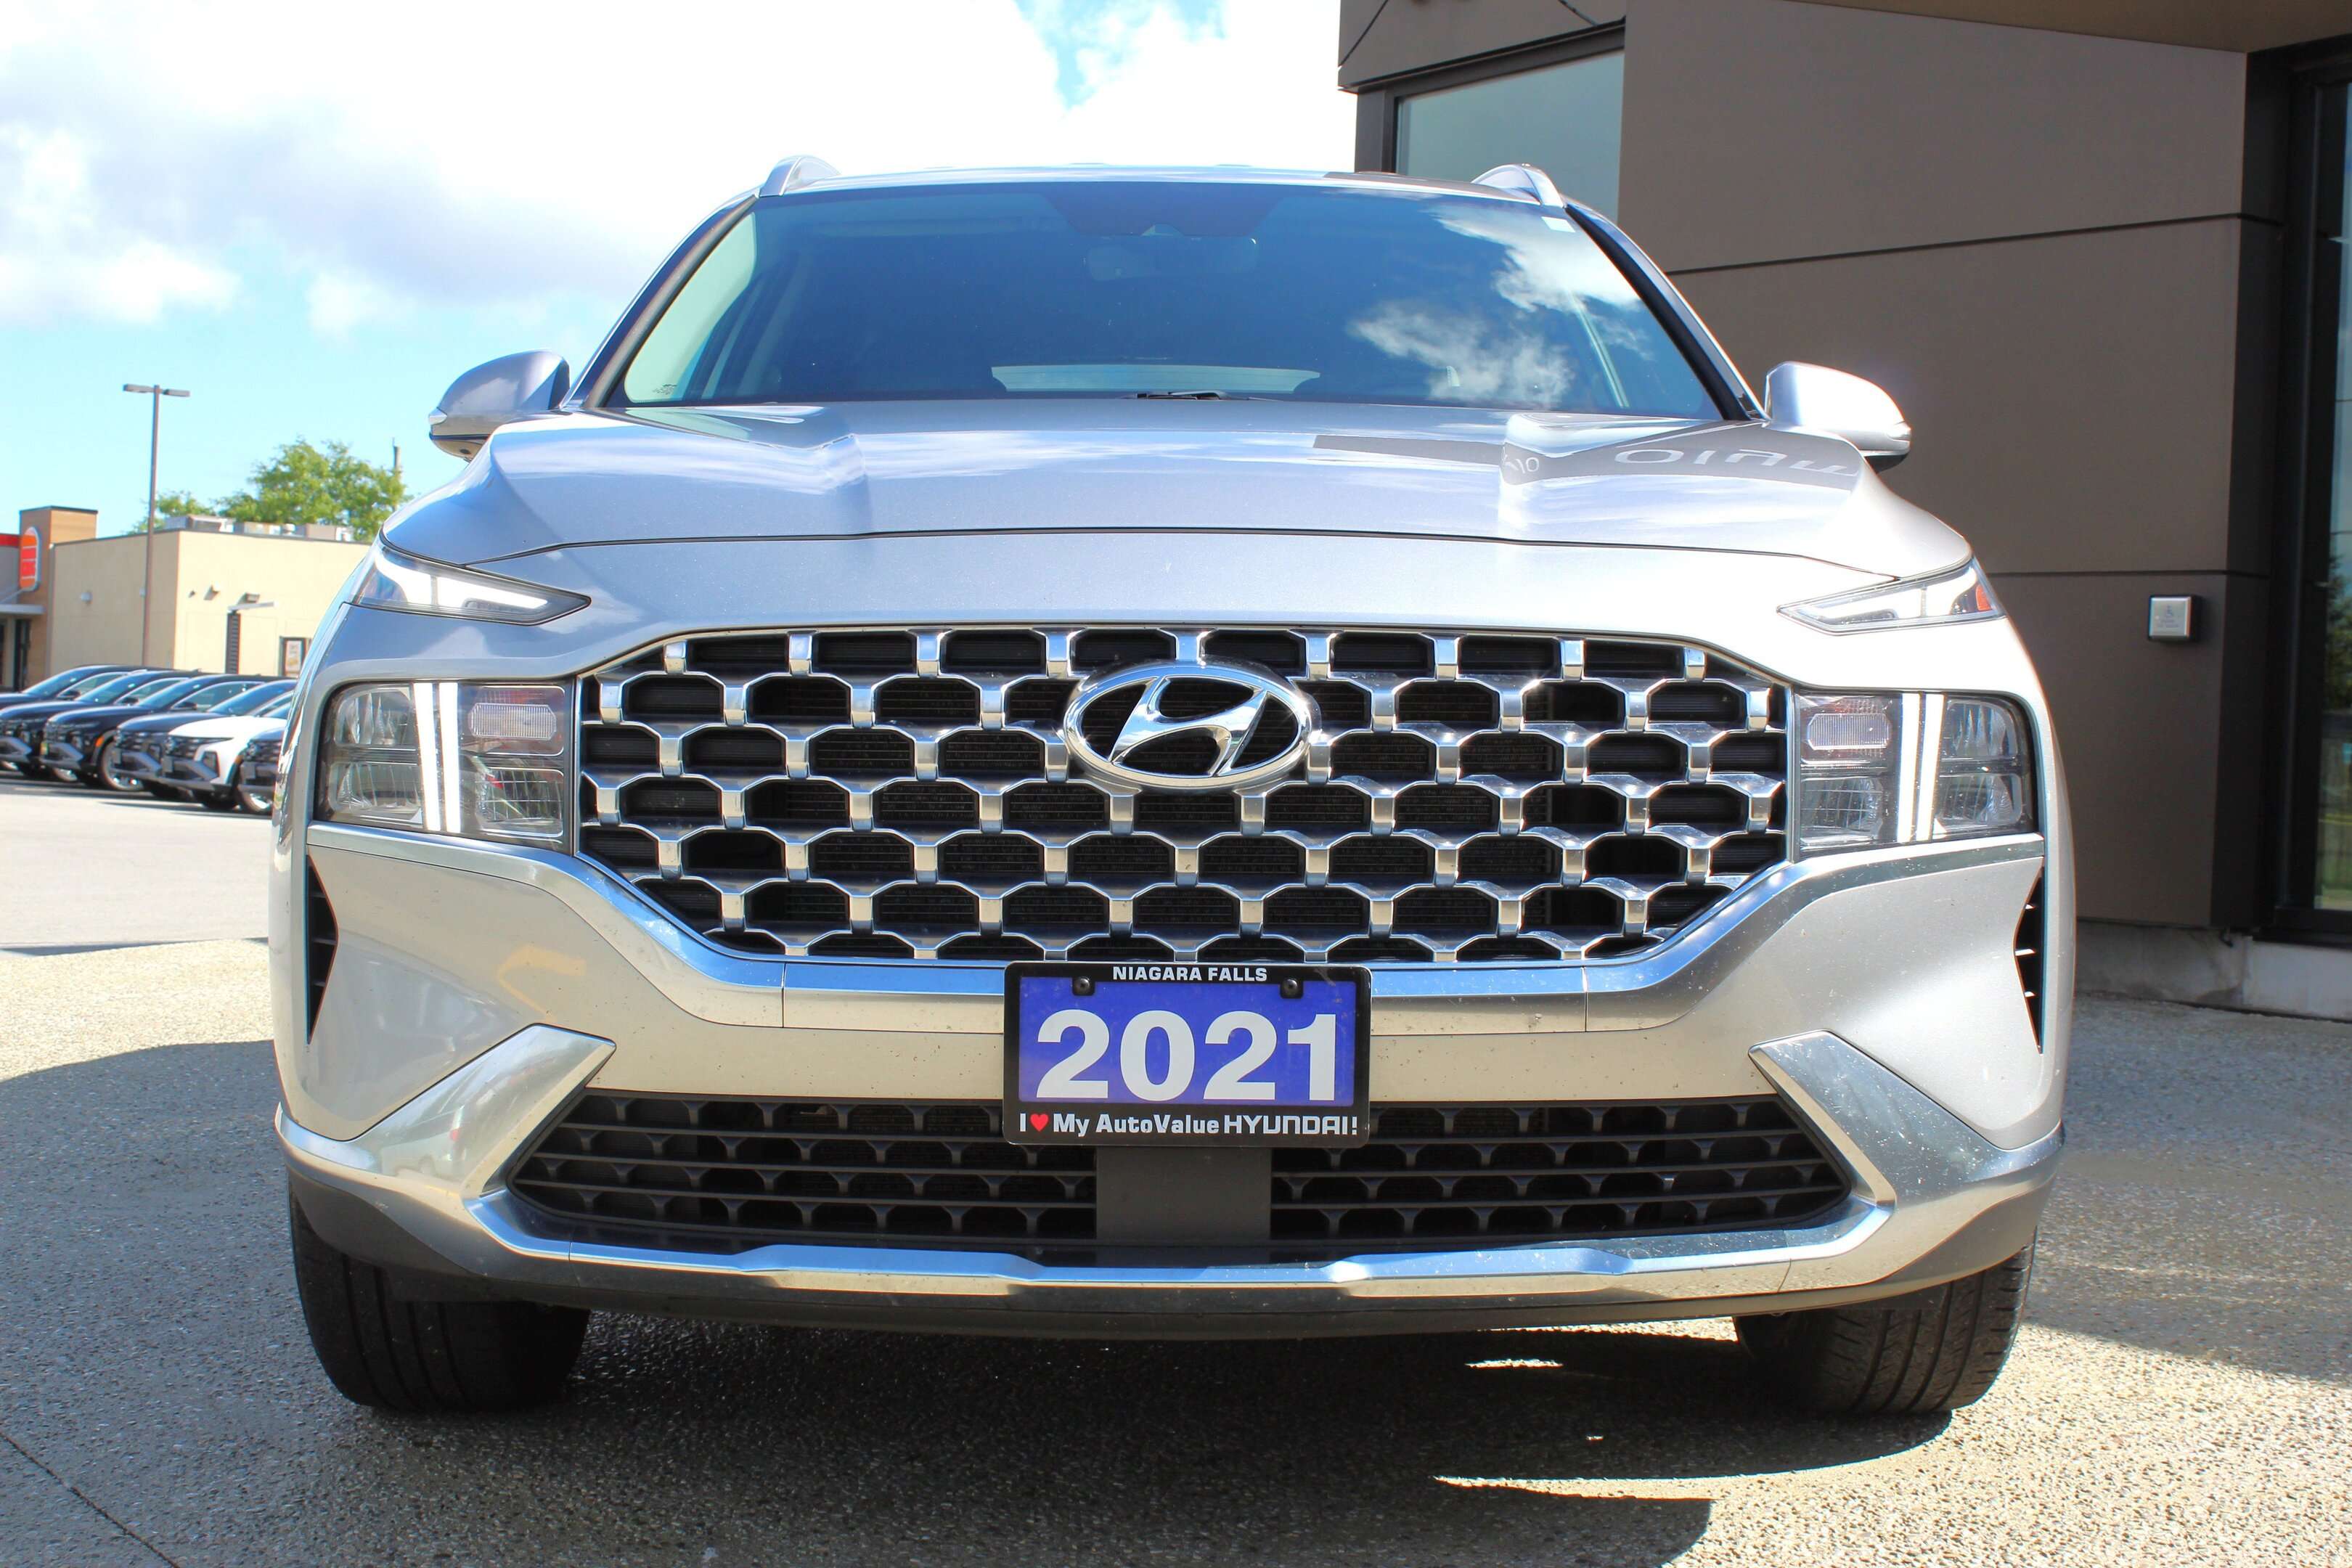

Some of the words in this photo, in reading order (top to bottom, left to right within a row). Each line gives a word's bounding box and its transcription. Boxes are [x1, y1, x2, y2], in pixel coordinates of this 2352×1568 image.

[1113, 966, 1202, 981] NIAGARA
[1208, 967, 1267, 981] FALLS
[1036, 1009, 1336, 1102] 2021
[1019, 1113, 1026, 1132] I
[1053, 1113, 1090, 1138] My
[1095, 1114, 1220, 1134] AutoValue
[1224, 1115, 1357, 1135] HYUNDAI!
